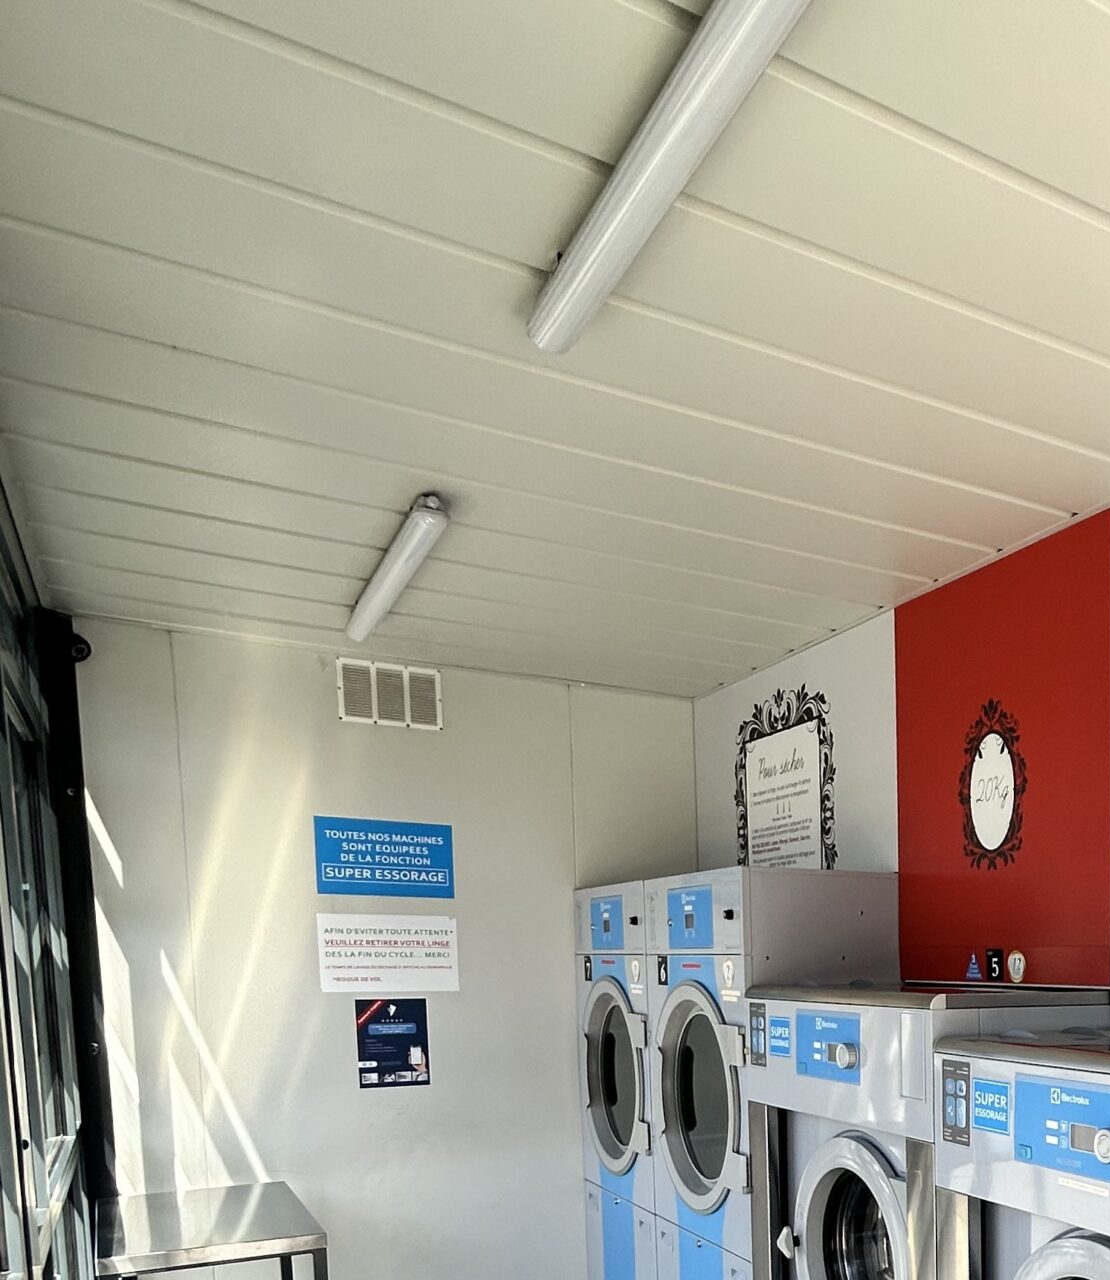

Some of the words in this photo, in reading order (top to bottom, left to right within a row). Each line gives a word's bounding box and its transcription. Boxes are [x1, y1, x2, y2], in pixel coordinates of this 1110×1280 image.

[975, 775, 1009, 809] 20Kg
[324, 830, 366, 840] TOUTES
[368, 833, 390, 842] NOS
[392, 834, 444, 845] MACHINES
[342, 842, 372, 852] SONT
[376, 844, 429, 855] EQUIPEES
[340, 853, 355, 862] DE
[358, 854, 372, 862] LA
[375, 855, 431, 865] FONCTION
[325, 867, 371, 879] SUPER
[375, 869, 446, 882] ESSORAGE
[586, 962, 591, 979] 7
[660, 963, 666, 982] 6
[991, 957, 999, 977] 5
[771, 1026, 789, 1037] SUPER
[975, 1091, 1007, 1109] SUPER
[1061, 1093, 1090, 1106] Electrolux
[975, 1107, 1007, 1122] ESSORAGE
